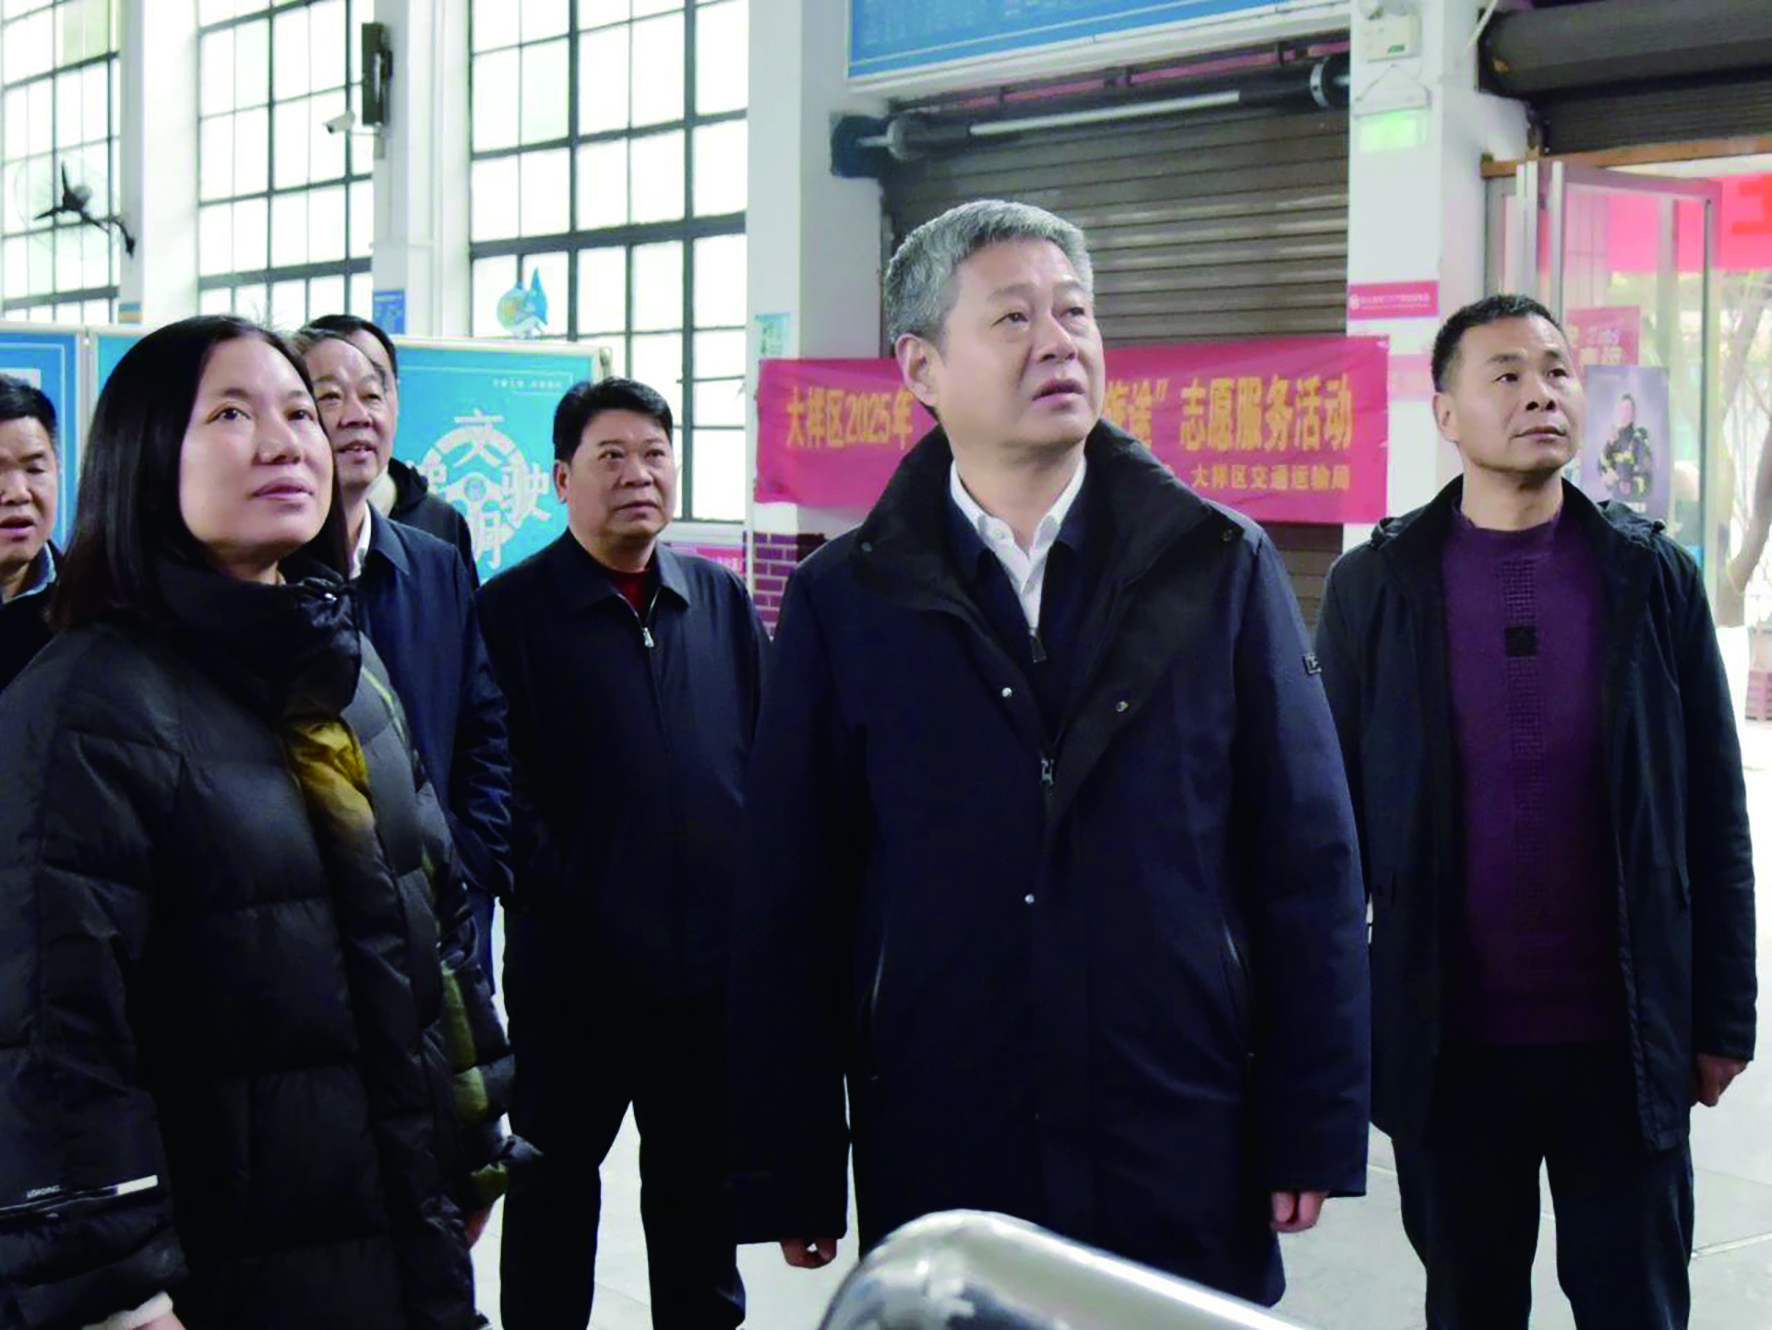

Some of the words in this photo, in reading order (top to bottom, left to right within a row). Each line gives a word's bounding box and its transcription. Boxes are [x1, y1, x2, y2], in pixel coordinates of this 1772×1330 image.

[786, 386, 914, 450] 大祥区2025年
[1180, 373, 1352, 451] 志愿服务活动
[1191, 463, 1351, 491] 大祥区交通运输局
